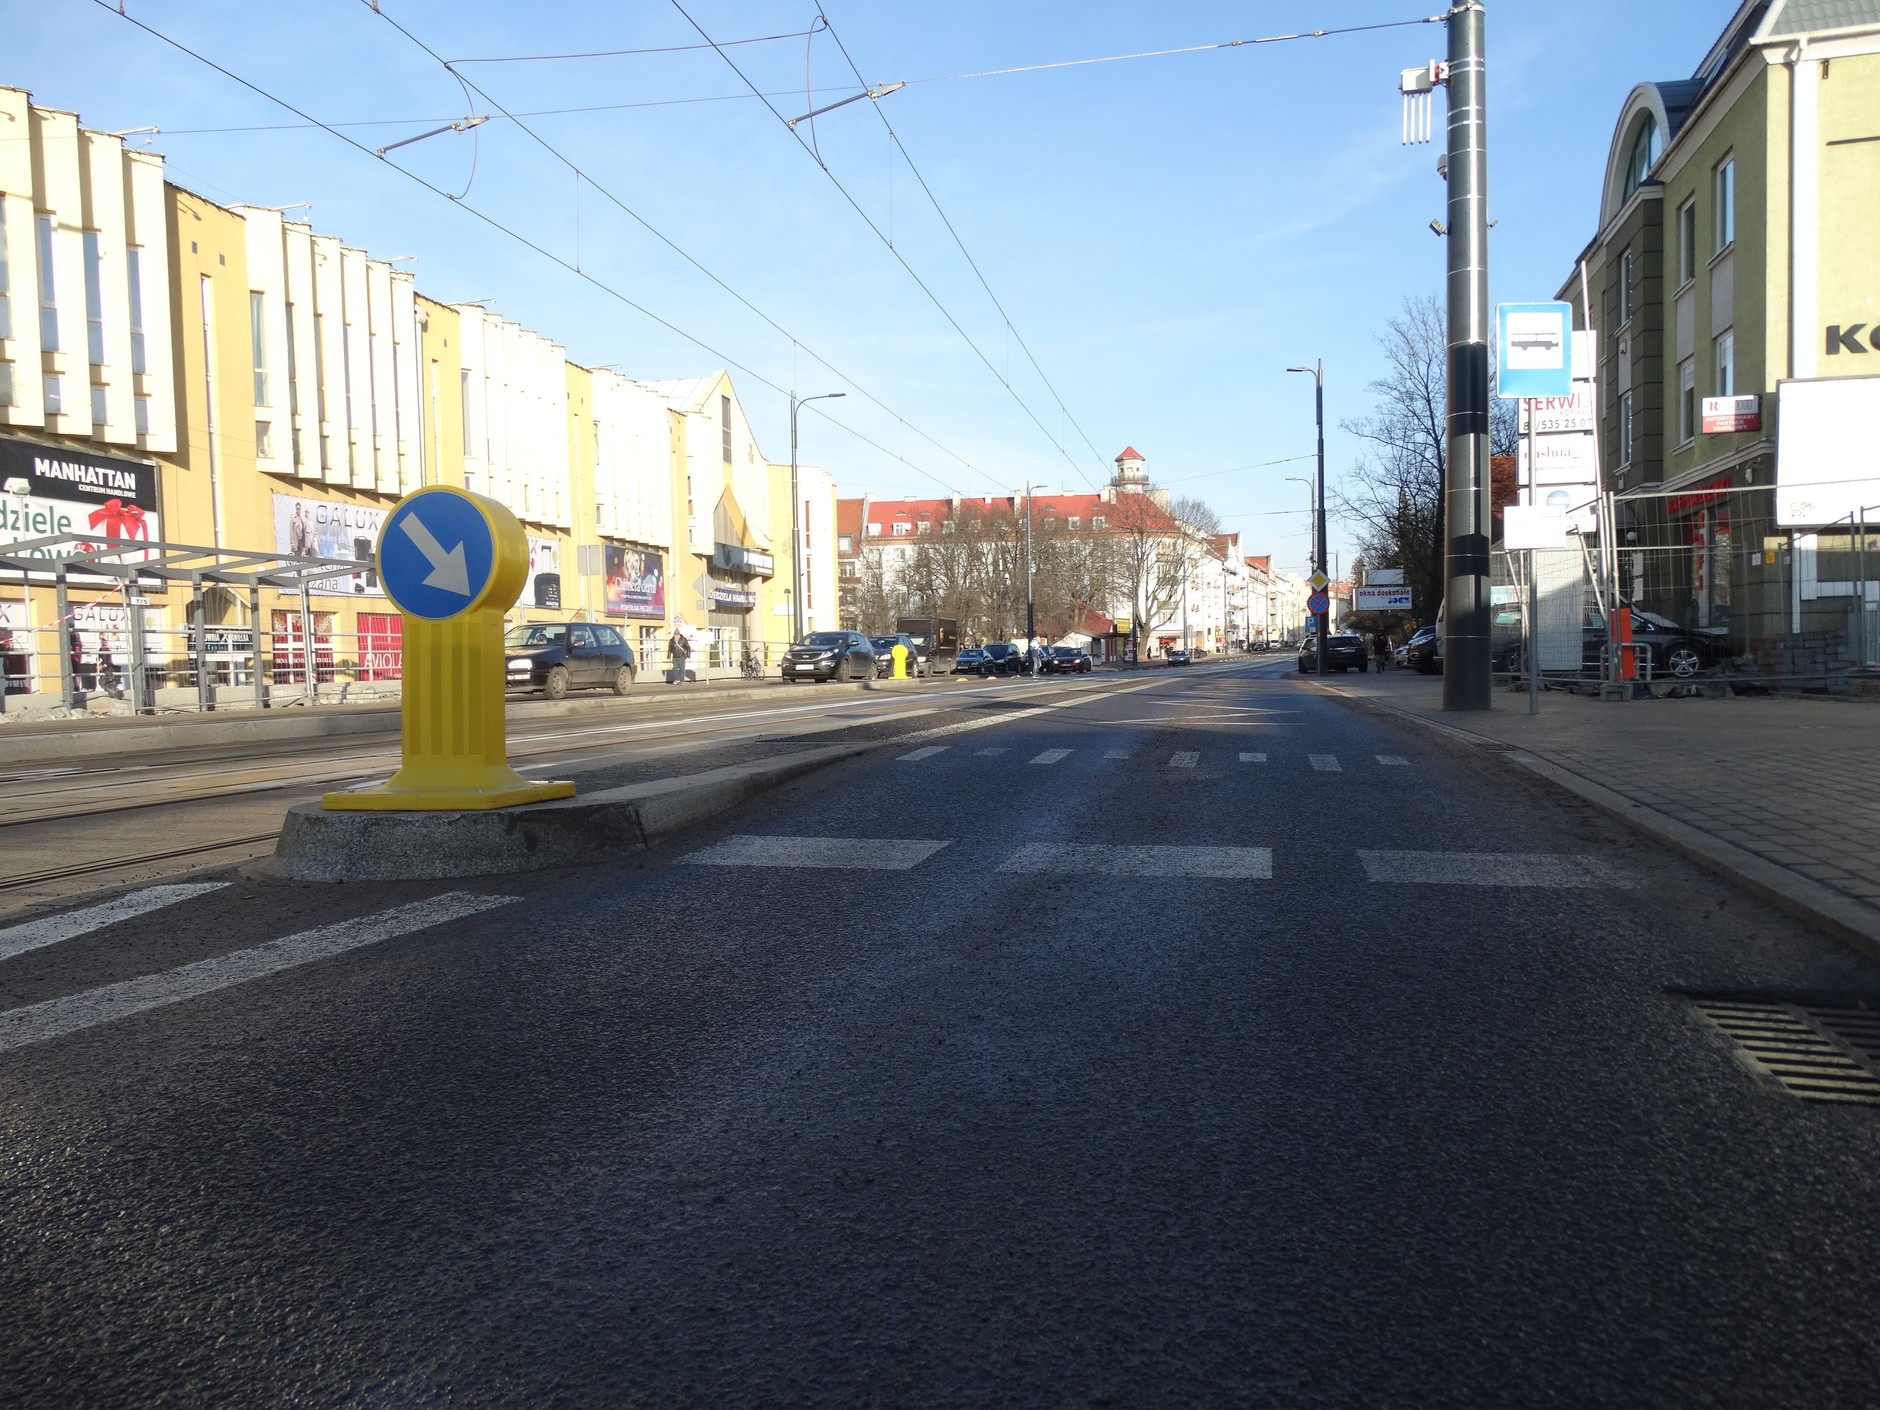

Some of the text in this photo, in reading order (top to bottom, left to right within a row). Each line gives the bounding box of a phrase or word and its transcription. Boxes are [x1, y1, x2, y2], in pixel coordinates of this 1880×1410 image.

[1825, 323, 1880, 355] K
[1564, 419, 1576, 428] 25
[34, 457, 137, 491] MANHATTAN
[78, 484, 137, 499] CENTRUM HANDLOWE
[316, 504, 379, 531] GALUX
[1359, 589, 1376, 597] okna
[364, 653, 402, 668] AVIOL
